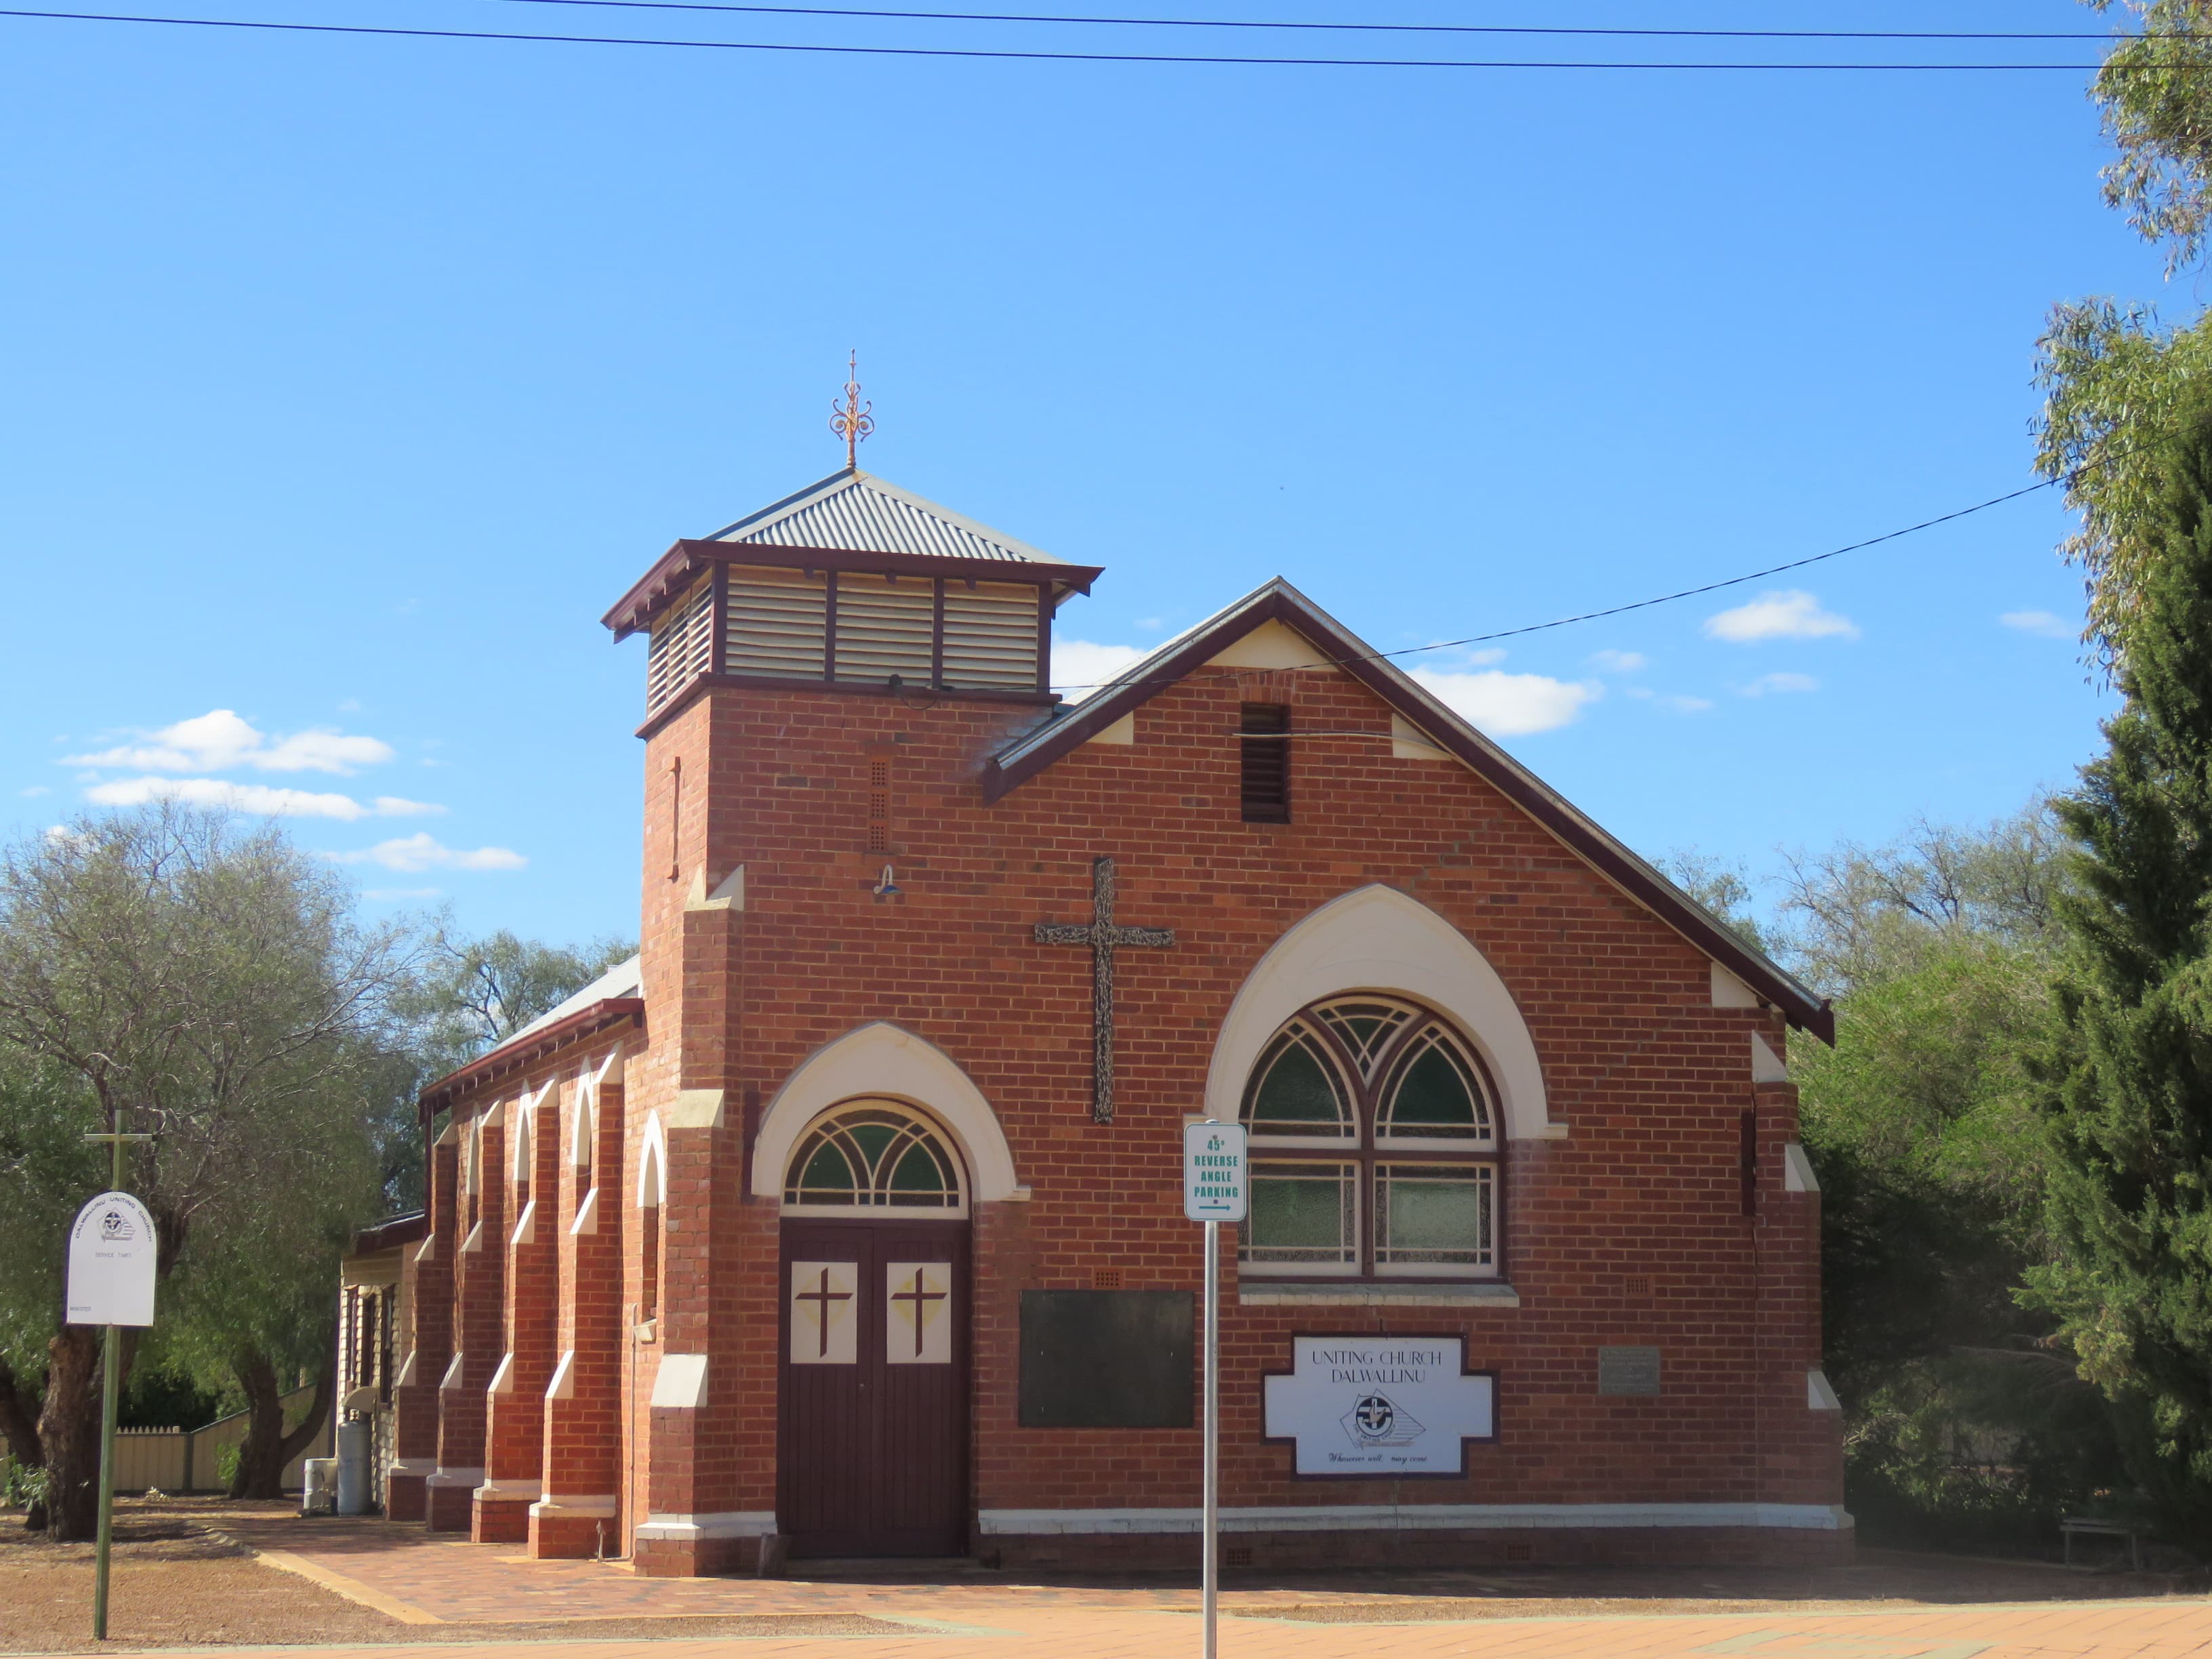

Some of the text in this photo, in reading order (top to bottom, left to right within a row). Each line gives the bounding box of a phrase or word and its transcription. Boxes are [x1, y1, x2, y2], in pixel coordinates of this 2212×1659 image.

[1194, 1155, 1238, 1166] REVERSE
[1201, 1171, 1231, 1182] ANGLE
[1194, 1187, 1238, 1197] PARKING
[75, 1199, 106, 1240] DALWALLINU
[110, 1196, 136, 1209] UNITING
[138, 1210, 152, 1242] CHURCH
[1312, 1350, 1442, 1365] UNITING CHURCH
[1332, 1369, 1425, 1383] DALWALLINU
[1391, 1456, 1408, 1465] may
